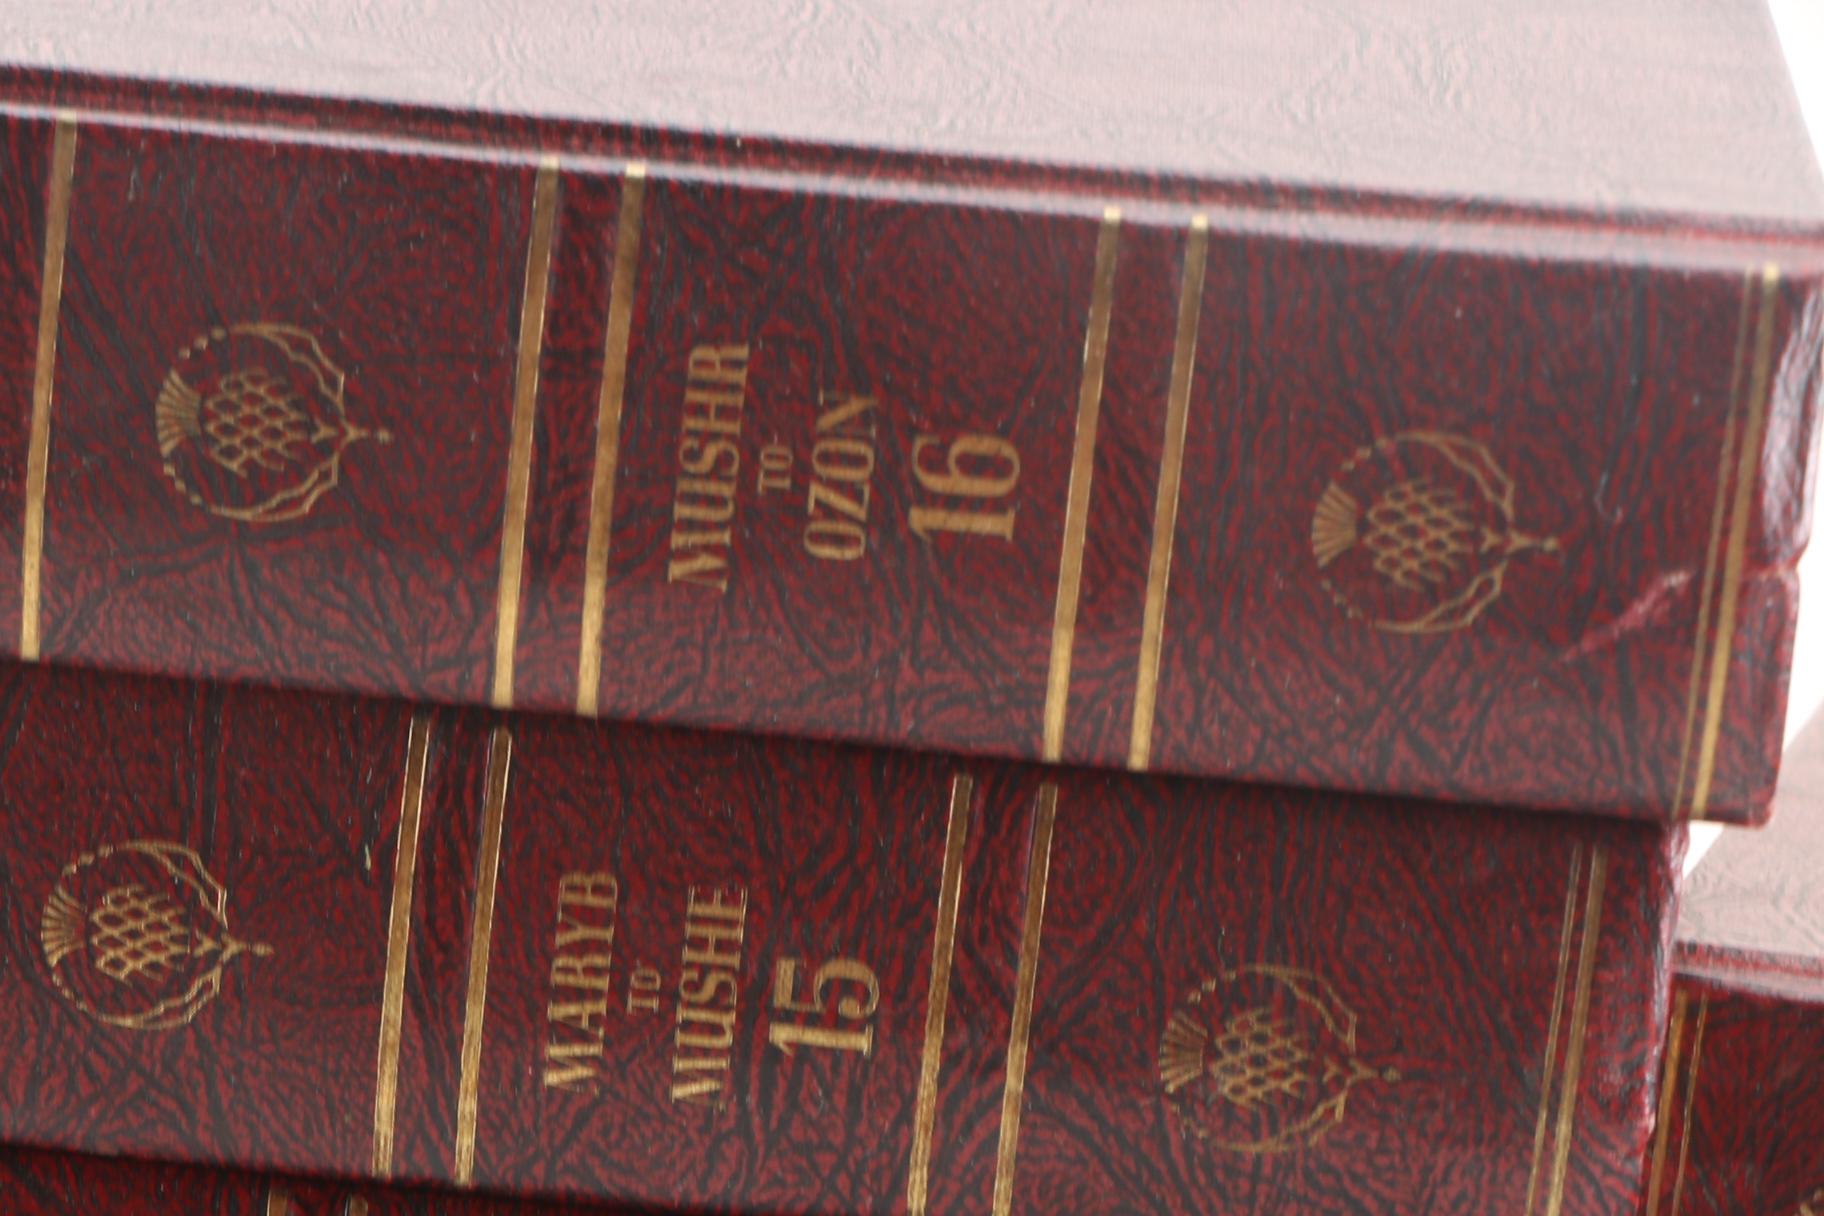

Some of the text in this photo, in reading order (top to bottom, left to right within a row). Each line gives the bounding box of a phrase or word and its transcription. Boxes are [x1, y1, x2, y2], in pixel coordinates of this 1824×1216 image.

[668, 343, 750, 593] MUSHR
[758, 443, 794, 496] TO
[804, 389, 878, 561] OZON
[909, 434, 1020, 544] 16
[543, 871, 618, 1097] MARYB
[627, 967, 662, 1016] TO
[671, 884, 748, 1112] MUSHE
[769, 956, 880, 1059] 15
